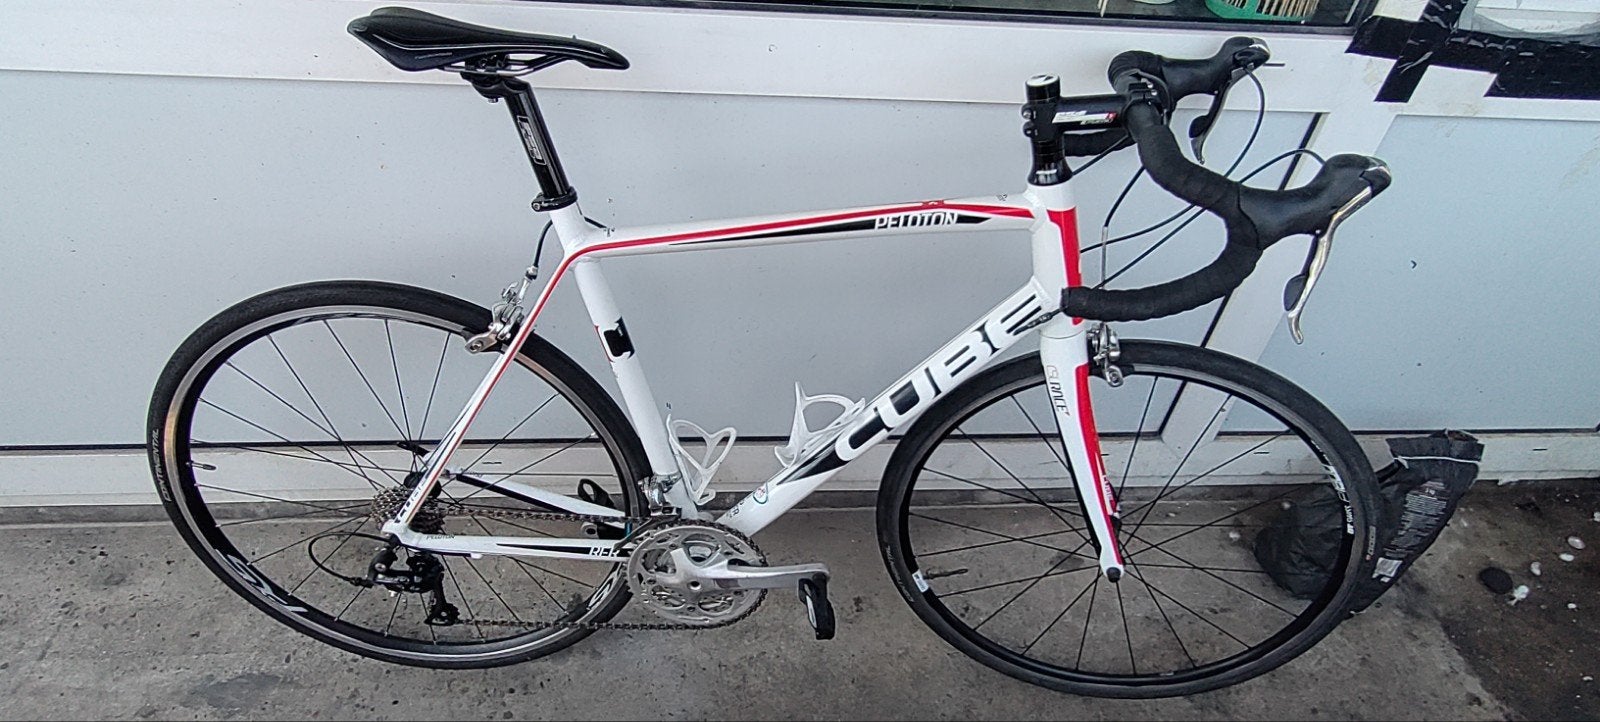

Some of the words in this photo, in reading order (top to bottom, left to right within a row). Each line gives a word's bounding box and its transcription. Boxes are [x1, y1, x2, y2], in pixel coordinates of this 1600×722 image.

[874, 210, 959, 230] PELOTON
[835, 287, 1046, 462] CUBE
[152, 428, 172, 502] CONTINENTAL
